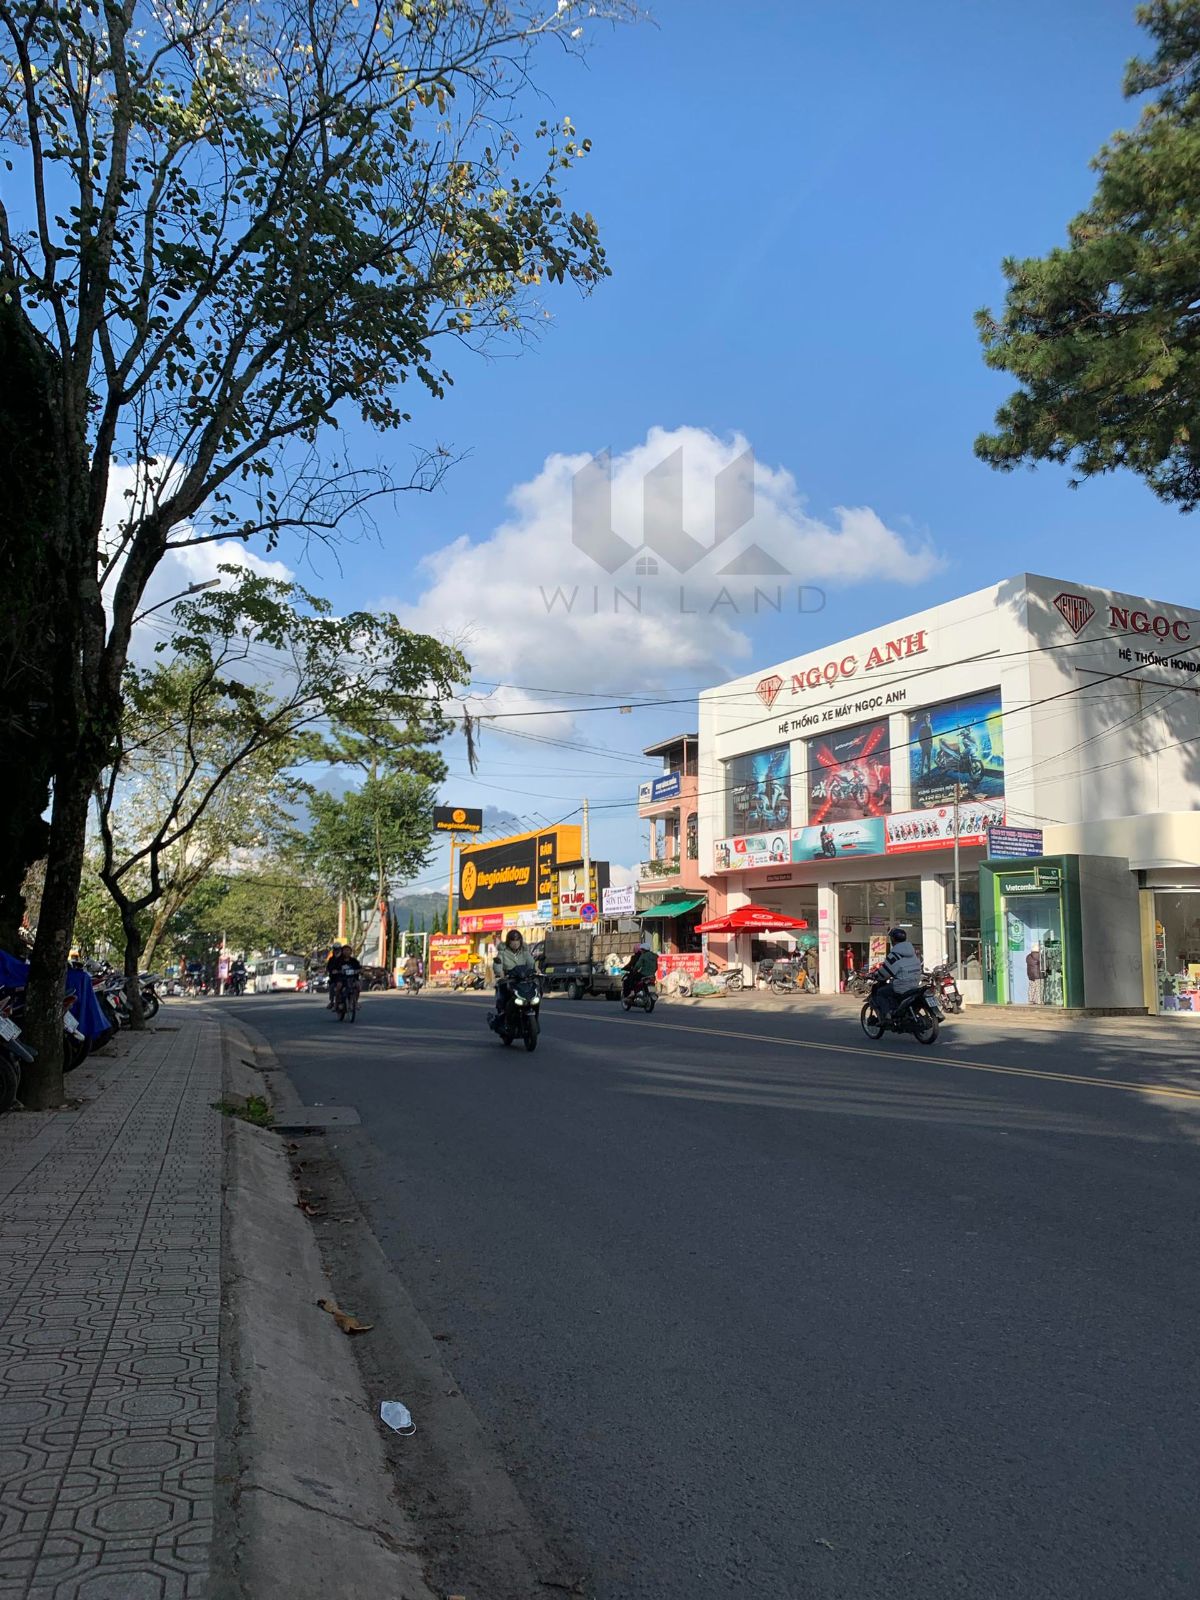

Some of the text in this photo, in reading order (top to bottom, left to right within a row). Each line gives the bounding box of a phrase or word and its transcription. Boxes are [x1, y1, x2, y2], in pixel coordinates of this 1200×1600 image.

[1109, 606, 1191, 643] NGỌC
[791, 656, 857, 694] NGỌC
[865, 630, 928, 670] ANH
[1118, 648, 1200, 673] HỆ THỐNG HONDA
[778, 689, 907, 734] HỆ THỐNG XE MÁY NGỌC ANH
